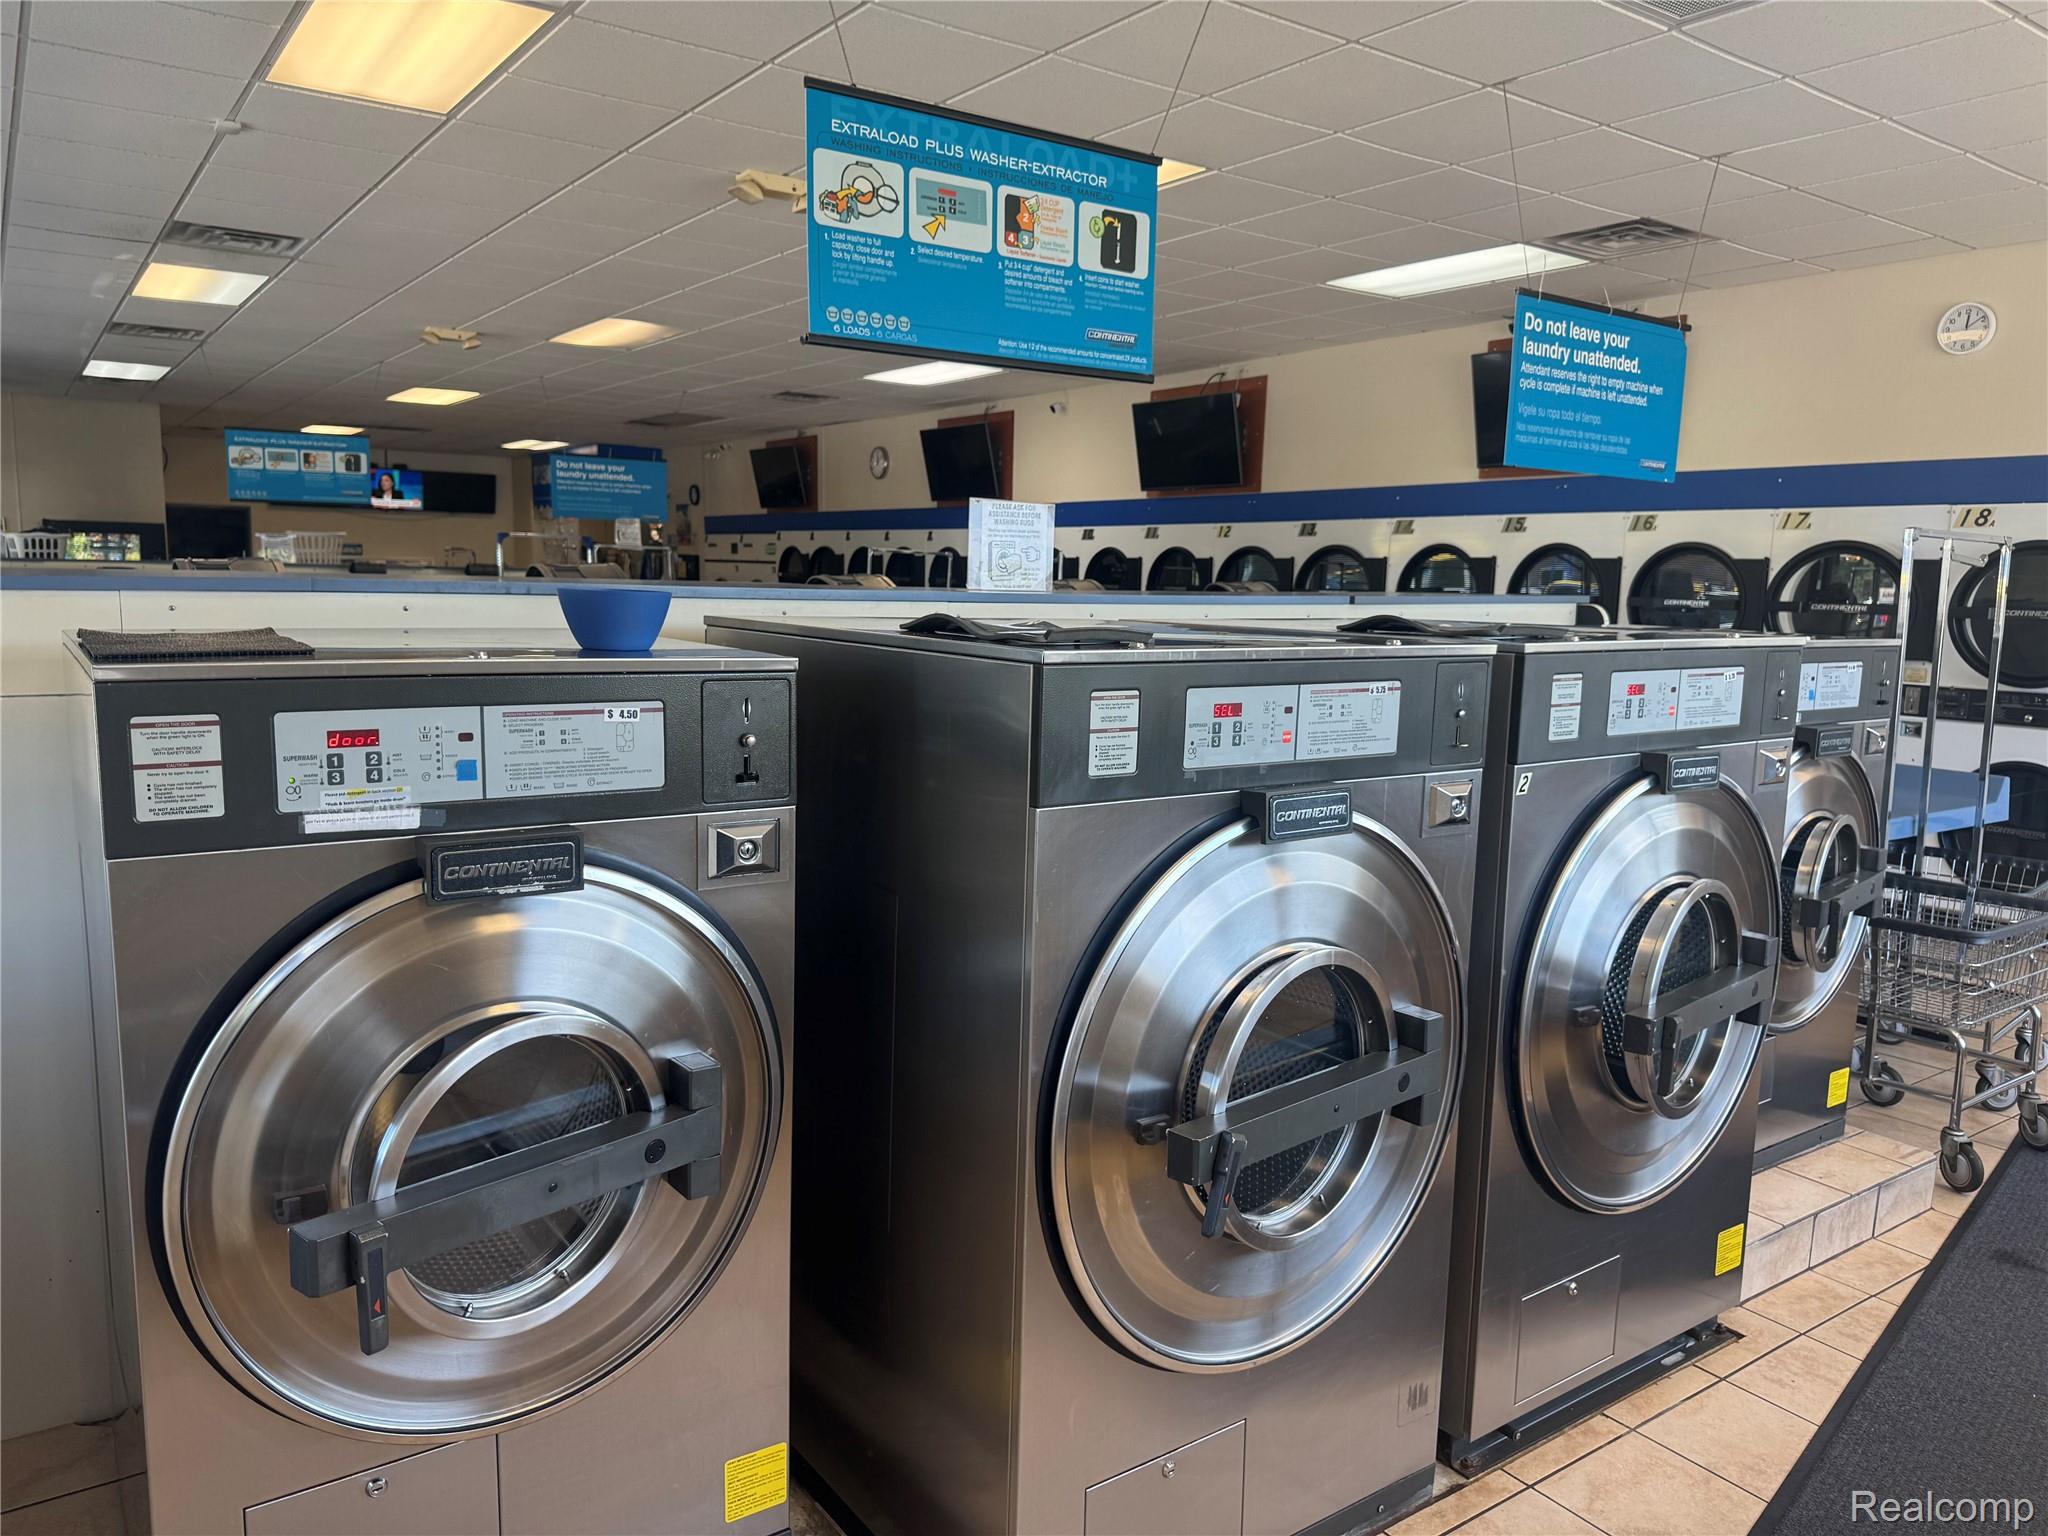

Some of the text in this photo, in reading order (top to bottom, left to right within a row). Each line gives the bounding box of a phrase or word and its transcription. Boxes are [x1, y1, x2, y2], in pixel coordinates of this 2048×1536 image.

[831, 118, 1107, 188] EXTRALOAD PLUS WASHER-EXTRACTOR
[831, 136, 881, 153] WASHING
[886, 148, 963, 170] INSTRUCTIONS
[978, 167, 1057, 191] INSTRUCCIONES
[1076, 187, 1114, 201] MANEJO
[1023, 213, 1029, 222] 2
[831, 230, 846, 240] Load
[1008, 232, 1015, 242] 4
[1022, 235, 1029, 245] 3
[833, 324, 840, 332] 6
[842, 325, 870, 336] LOADS
[885, 332, 917, 343] CARGAS
[1524, 311, 1630, 349] Do not leave your
[1522, 336, 1641, 374] laundry unattended.
[1520, 361, 1664, 396] Attendant reserves the right to empty machine when
[1520, 377, 1536, 390] cycle
[1537, 379, 1542, 390] is
[1543, 381, 1571, 396] complete
[1576, 386, 1600, 400] machine
[1601, 388, 1606, 400] is
[1607, 390, 1616, 402] left
[556, 460, 625, 473] Do not leave your
[556, 469, 634, 482] laundry unattended.
[1811, 603, 1867, 613] CONTINENTAL
[607, 709, 638, 719] $ 4.50
[1214, 724, 1219, 733] 1
[1235, 723, 1241, 732] 2
[1213, 737, 1219, 746] 3
[1235, 735, 1240, 745] 4
[283, 754, 318, 762] SUPERWASH
[331, 756, 338, 766] 1
[369, 754, 378, 765] 2
[331, 772, 340, 782] 3
[370, 770, 379, 780] 4
[1519, 775, 1529, 793] 2
[1276, 804, 1347, 822] CONTINENTAL
[444, 856, 571, 880] CONTINENTAL
